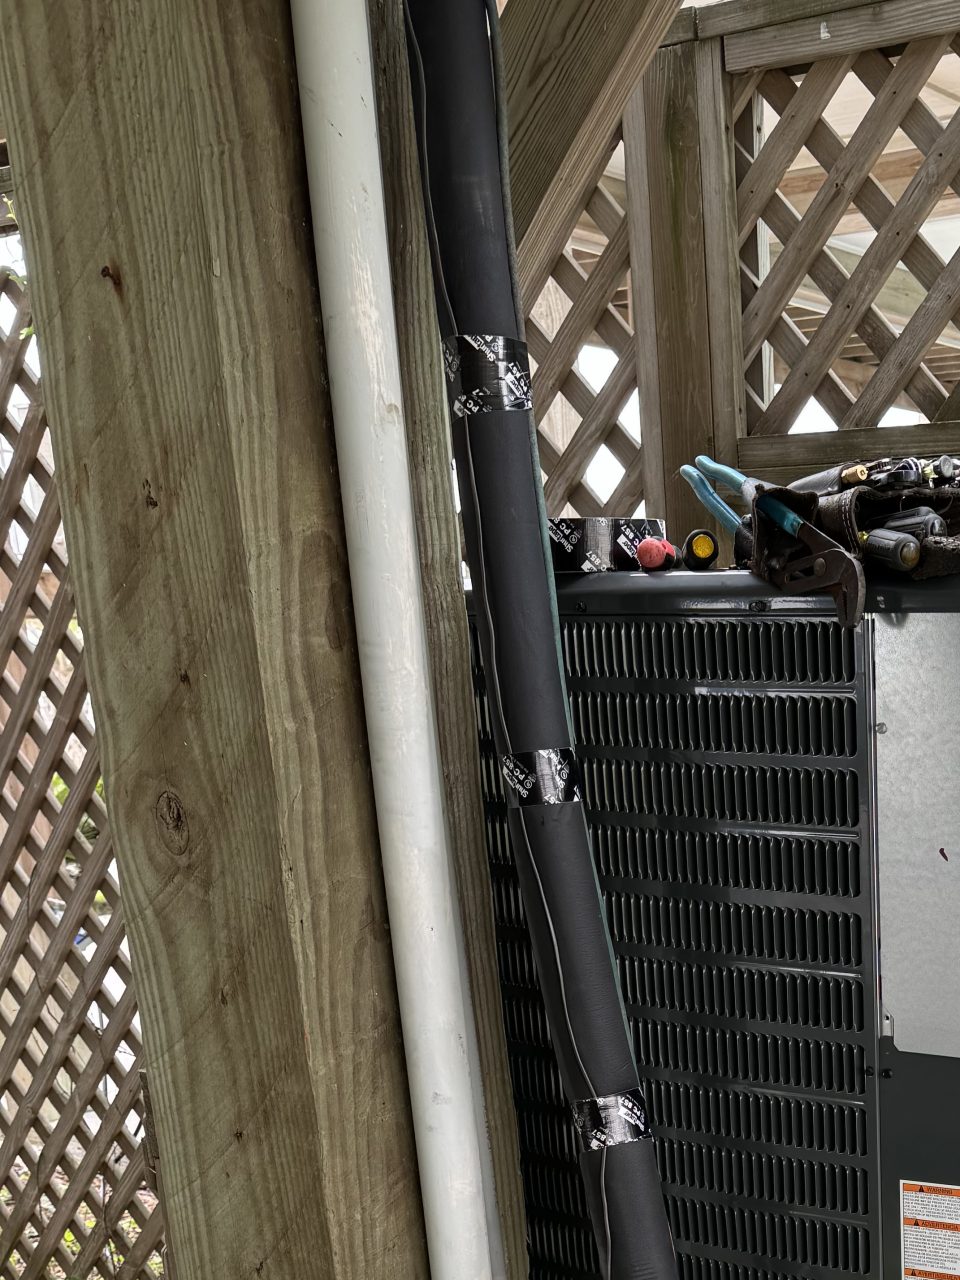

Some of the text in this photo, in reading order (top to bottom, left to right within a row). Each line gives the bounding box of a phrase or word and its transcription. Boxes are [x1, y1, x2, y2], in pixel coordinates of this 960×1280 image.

[559, 521, 572, 536] PC
[620, 524, 634, 539] 857
[585, 550, 601, 566] 857
